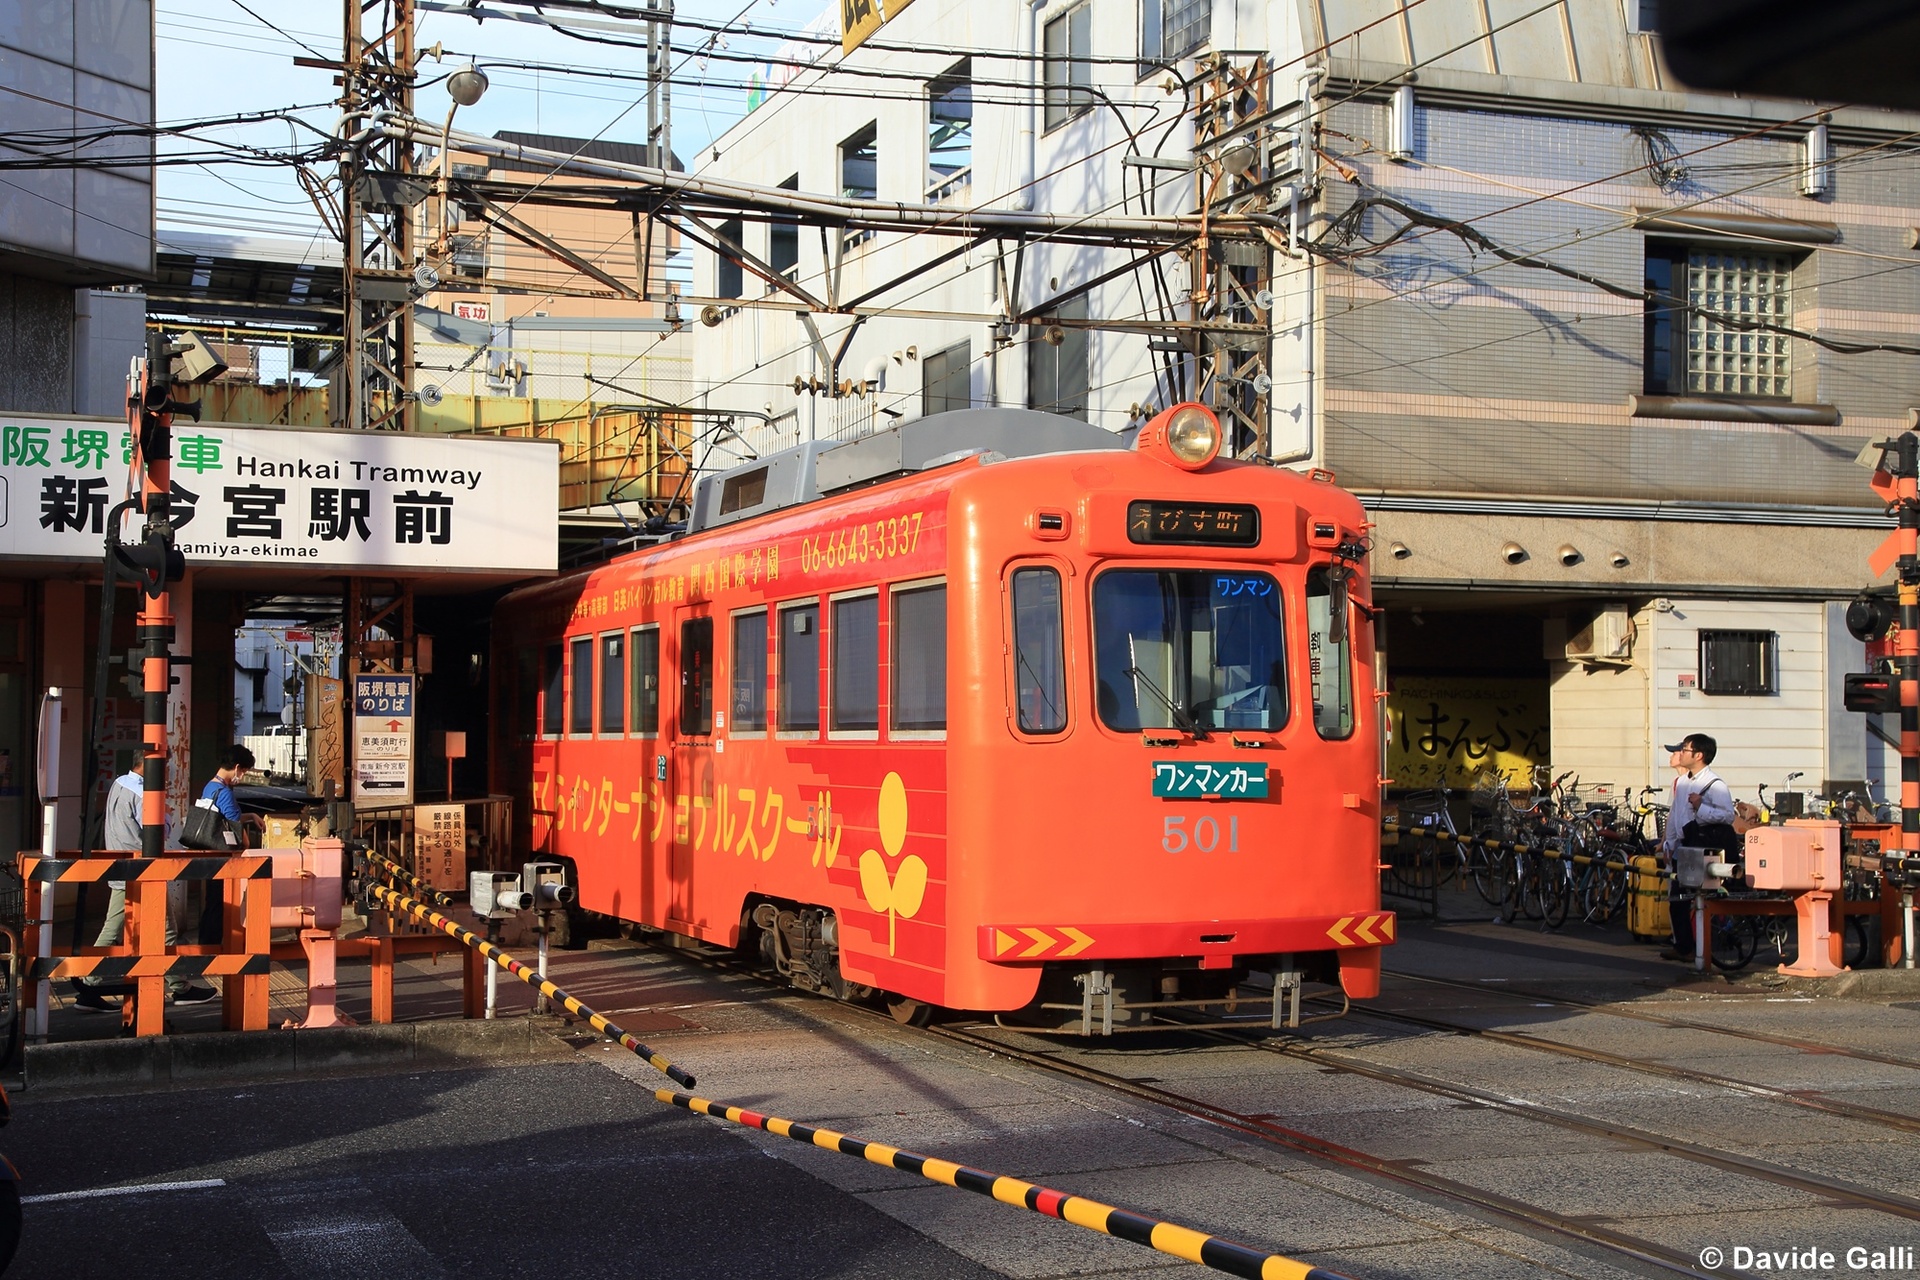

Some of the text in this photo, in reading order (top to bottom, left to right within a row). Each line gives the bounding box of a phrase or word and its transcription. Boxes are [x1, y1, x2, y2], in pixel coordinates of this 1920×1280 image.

[237, 456, 482, 490] Hankai Tramway
[613, 576, 685, 614] 日英バイリンガル教育
[690, 543, 779, 598] 関西国際学園
[801, 511, 924, 574] 06-6643-3337
[1216, 578, 1273, 597] ワンマン
[358, 681, 410, 697] 阪堺電車
[362, 698, 405, 711] のりば
[1400, 688, 1519, 700] PACHINKO&SLOT
[361, 737, 408, 746] 恵美須町行
[1156, 764, 1265, 794] ワンマンカー
[433, 812, 442, 849] 厳禁する
[443, 811, 452, 876] 線路内の通行を
[453, 811, 462, 848] 係員以外
[1162, 815, 1240, 854] 501
